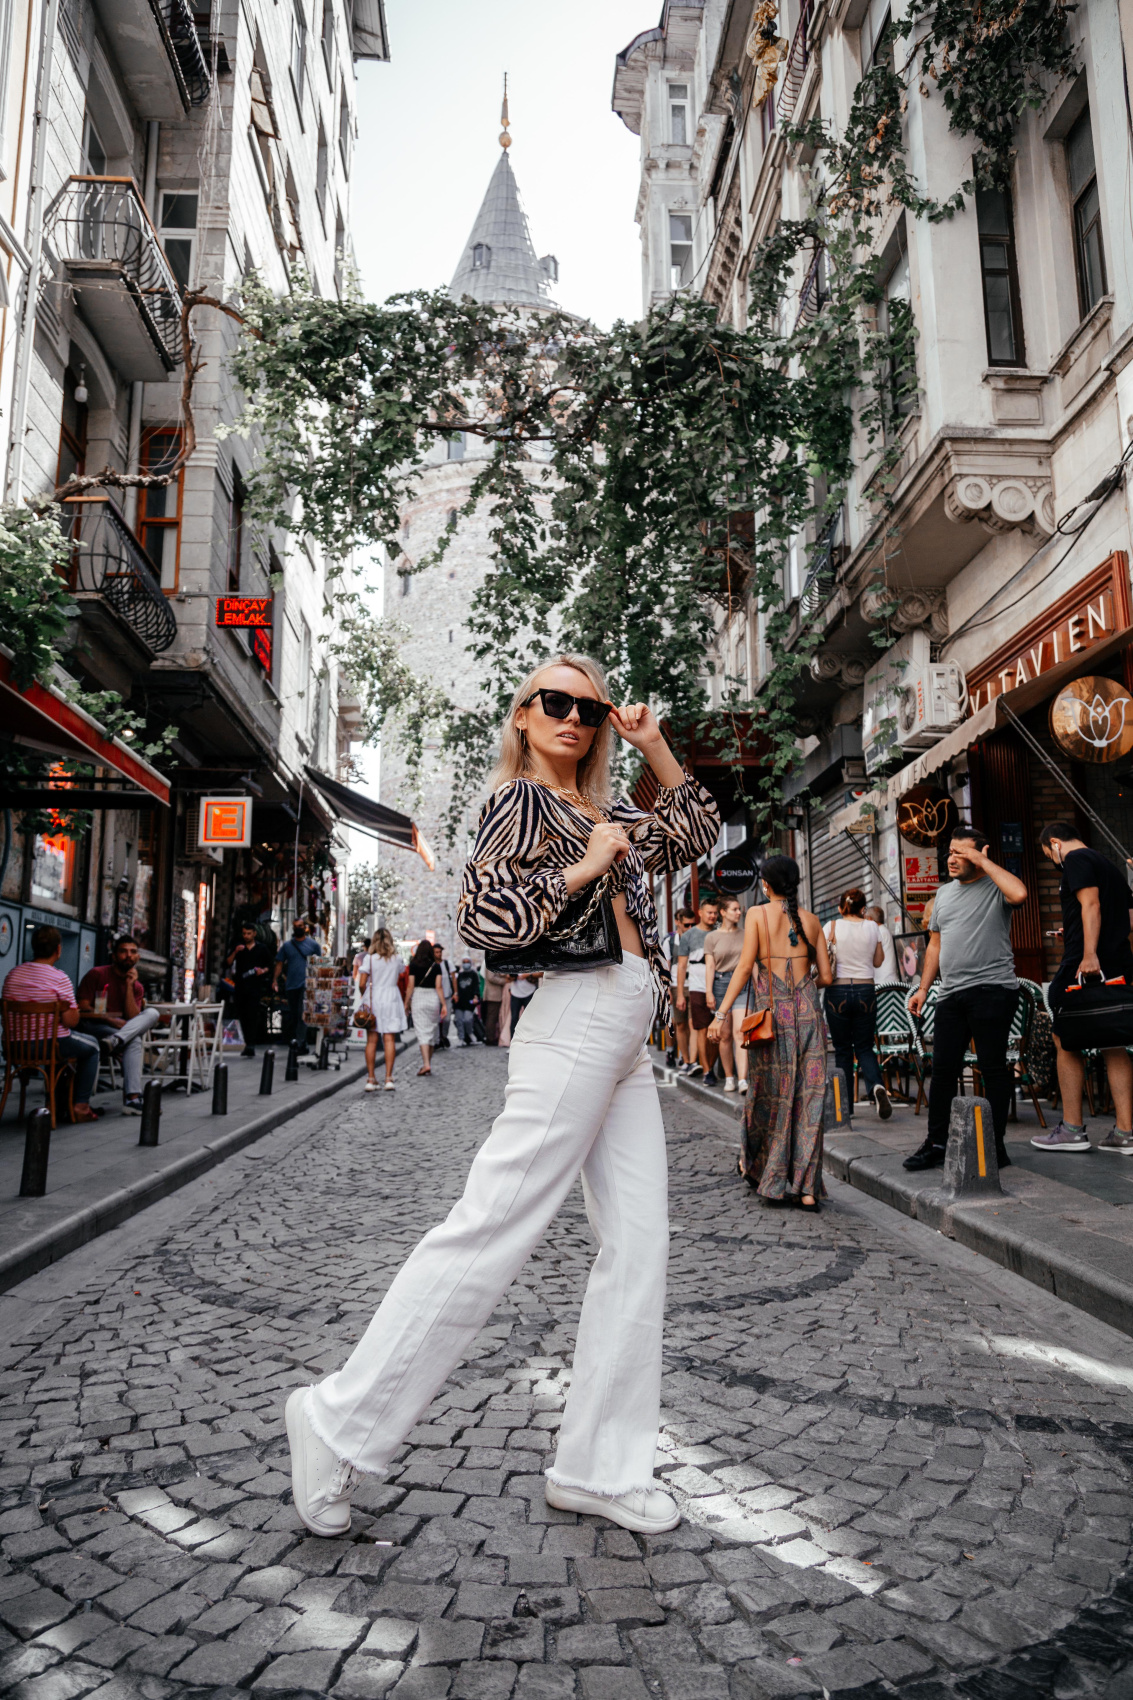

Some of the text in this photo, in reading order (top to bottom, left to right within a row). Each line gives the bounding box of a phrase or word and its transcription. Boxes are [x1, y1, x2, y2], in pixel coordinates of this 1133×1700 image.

[224, 600, 267, 613] DİNÇAY
[224, 613, 266, 623] EMLAK
[969, 595, 1106, 715] VITAVIEN
[871, 756, 928, 804] VIAVIEN
[211, 807, 238, 837] E
